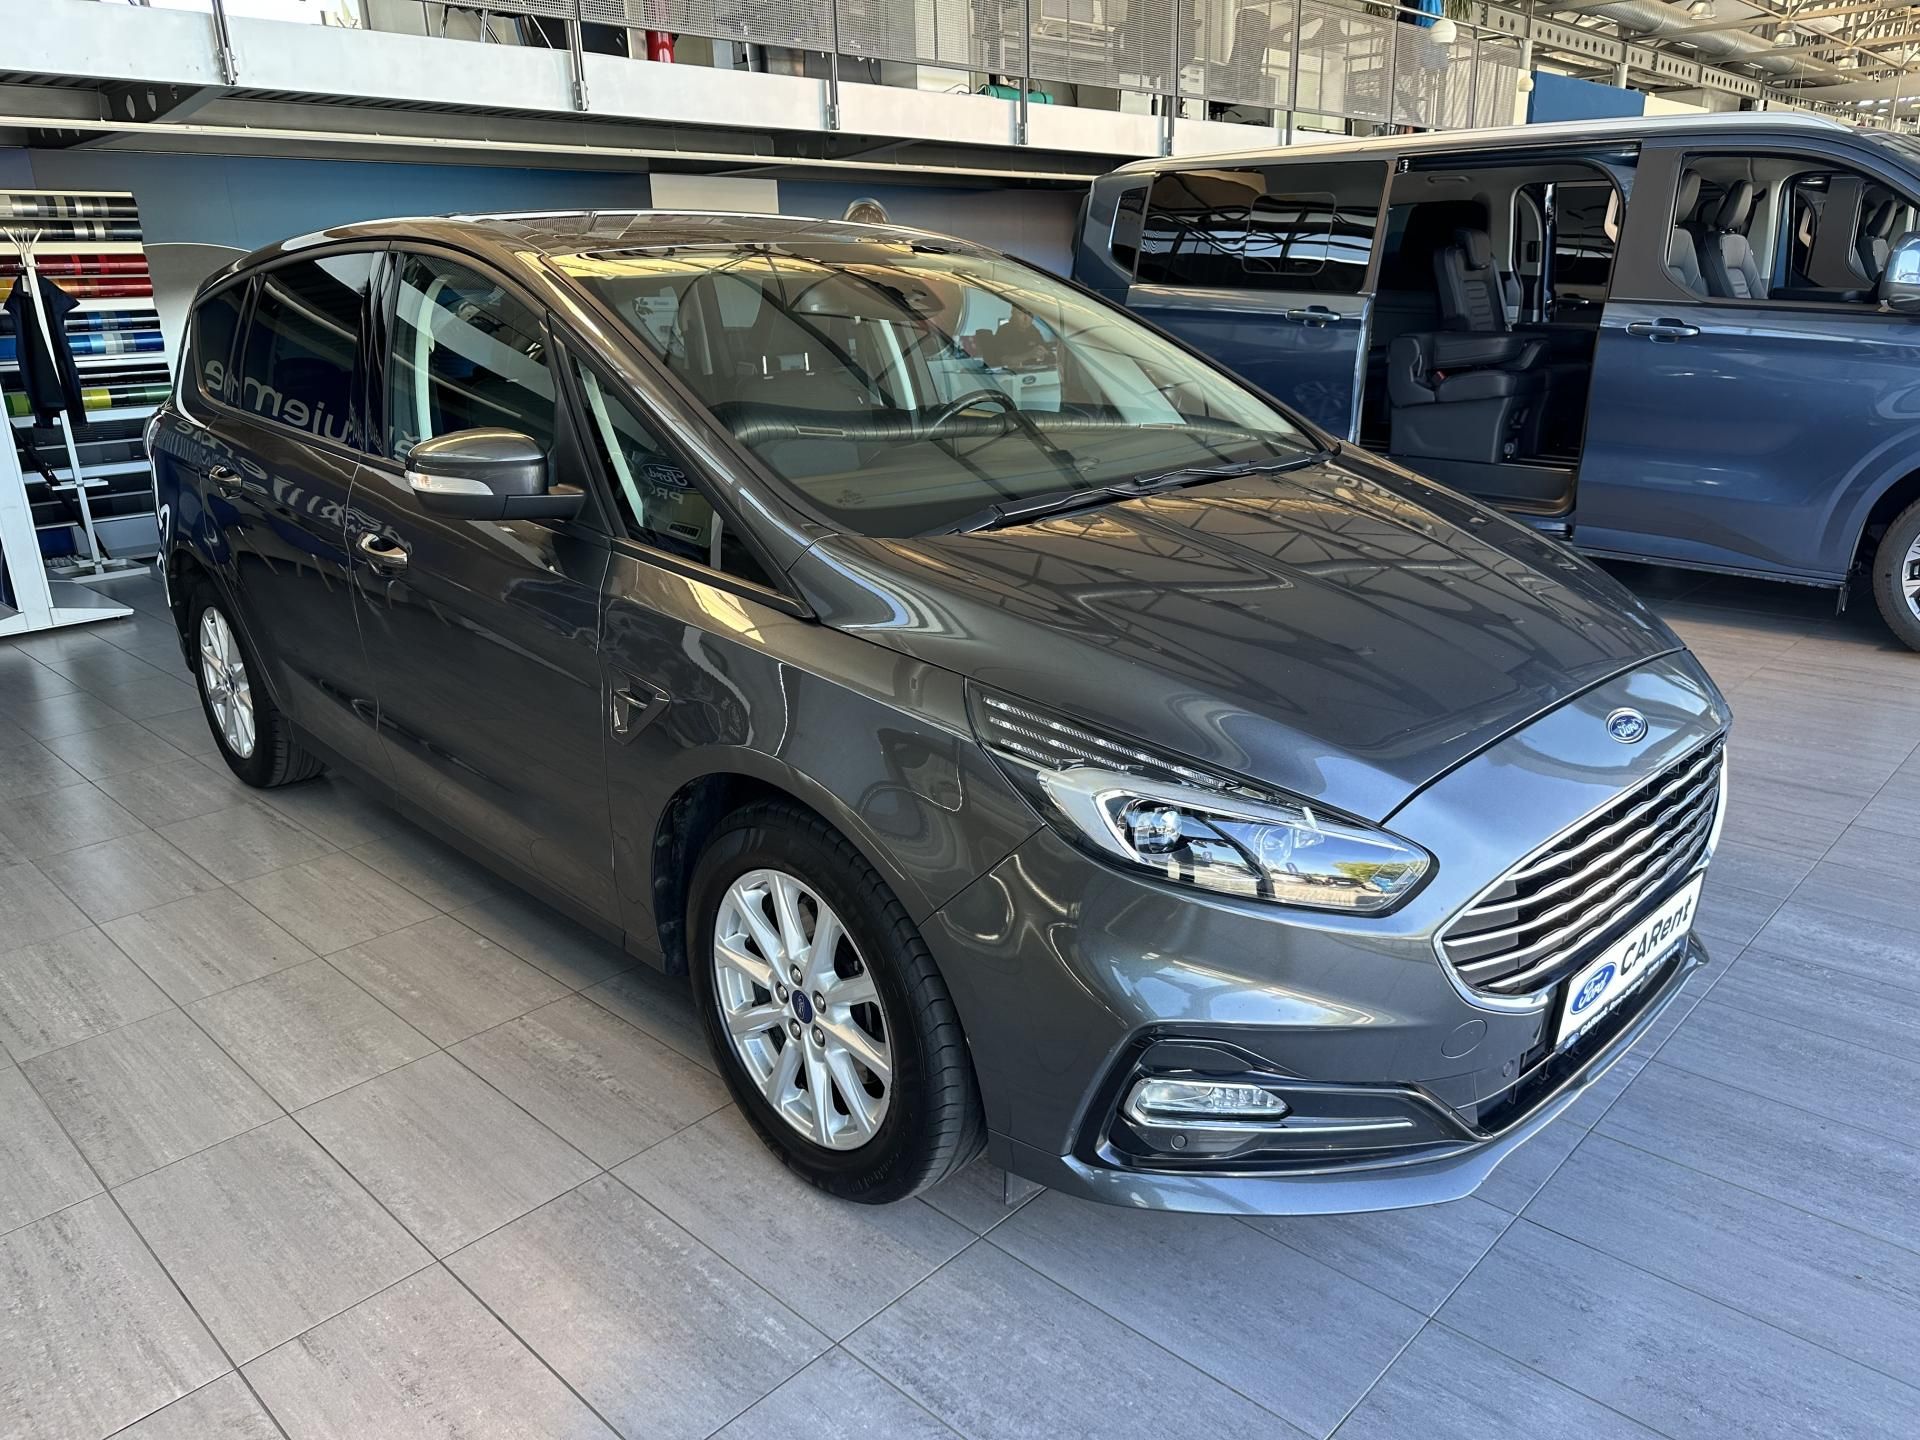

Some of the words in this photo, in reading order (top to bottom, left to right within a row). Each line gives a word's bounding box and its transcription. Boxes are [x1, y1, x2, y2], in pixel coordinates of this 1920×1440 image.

[1614, 717, 1642, 738] Ford
[1620, 894, 1692, 976] CARent
[1577, 970, 1611, 1010] Ford
